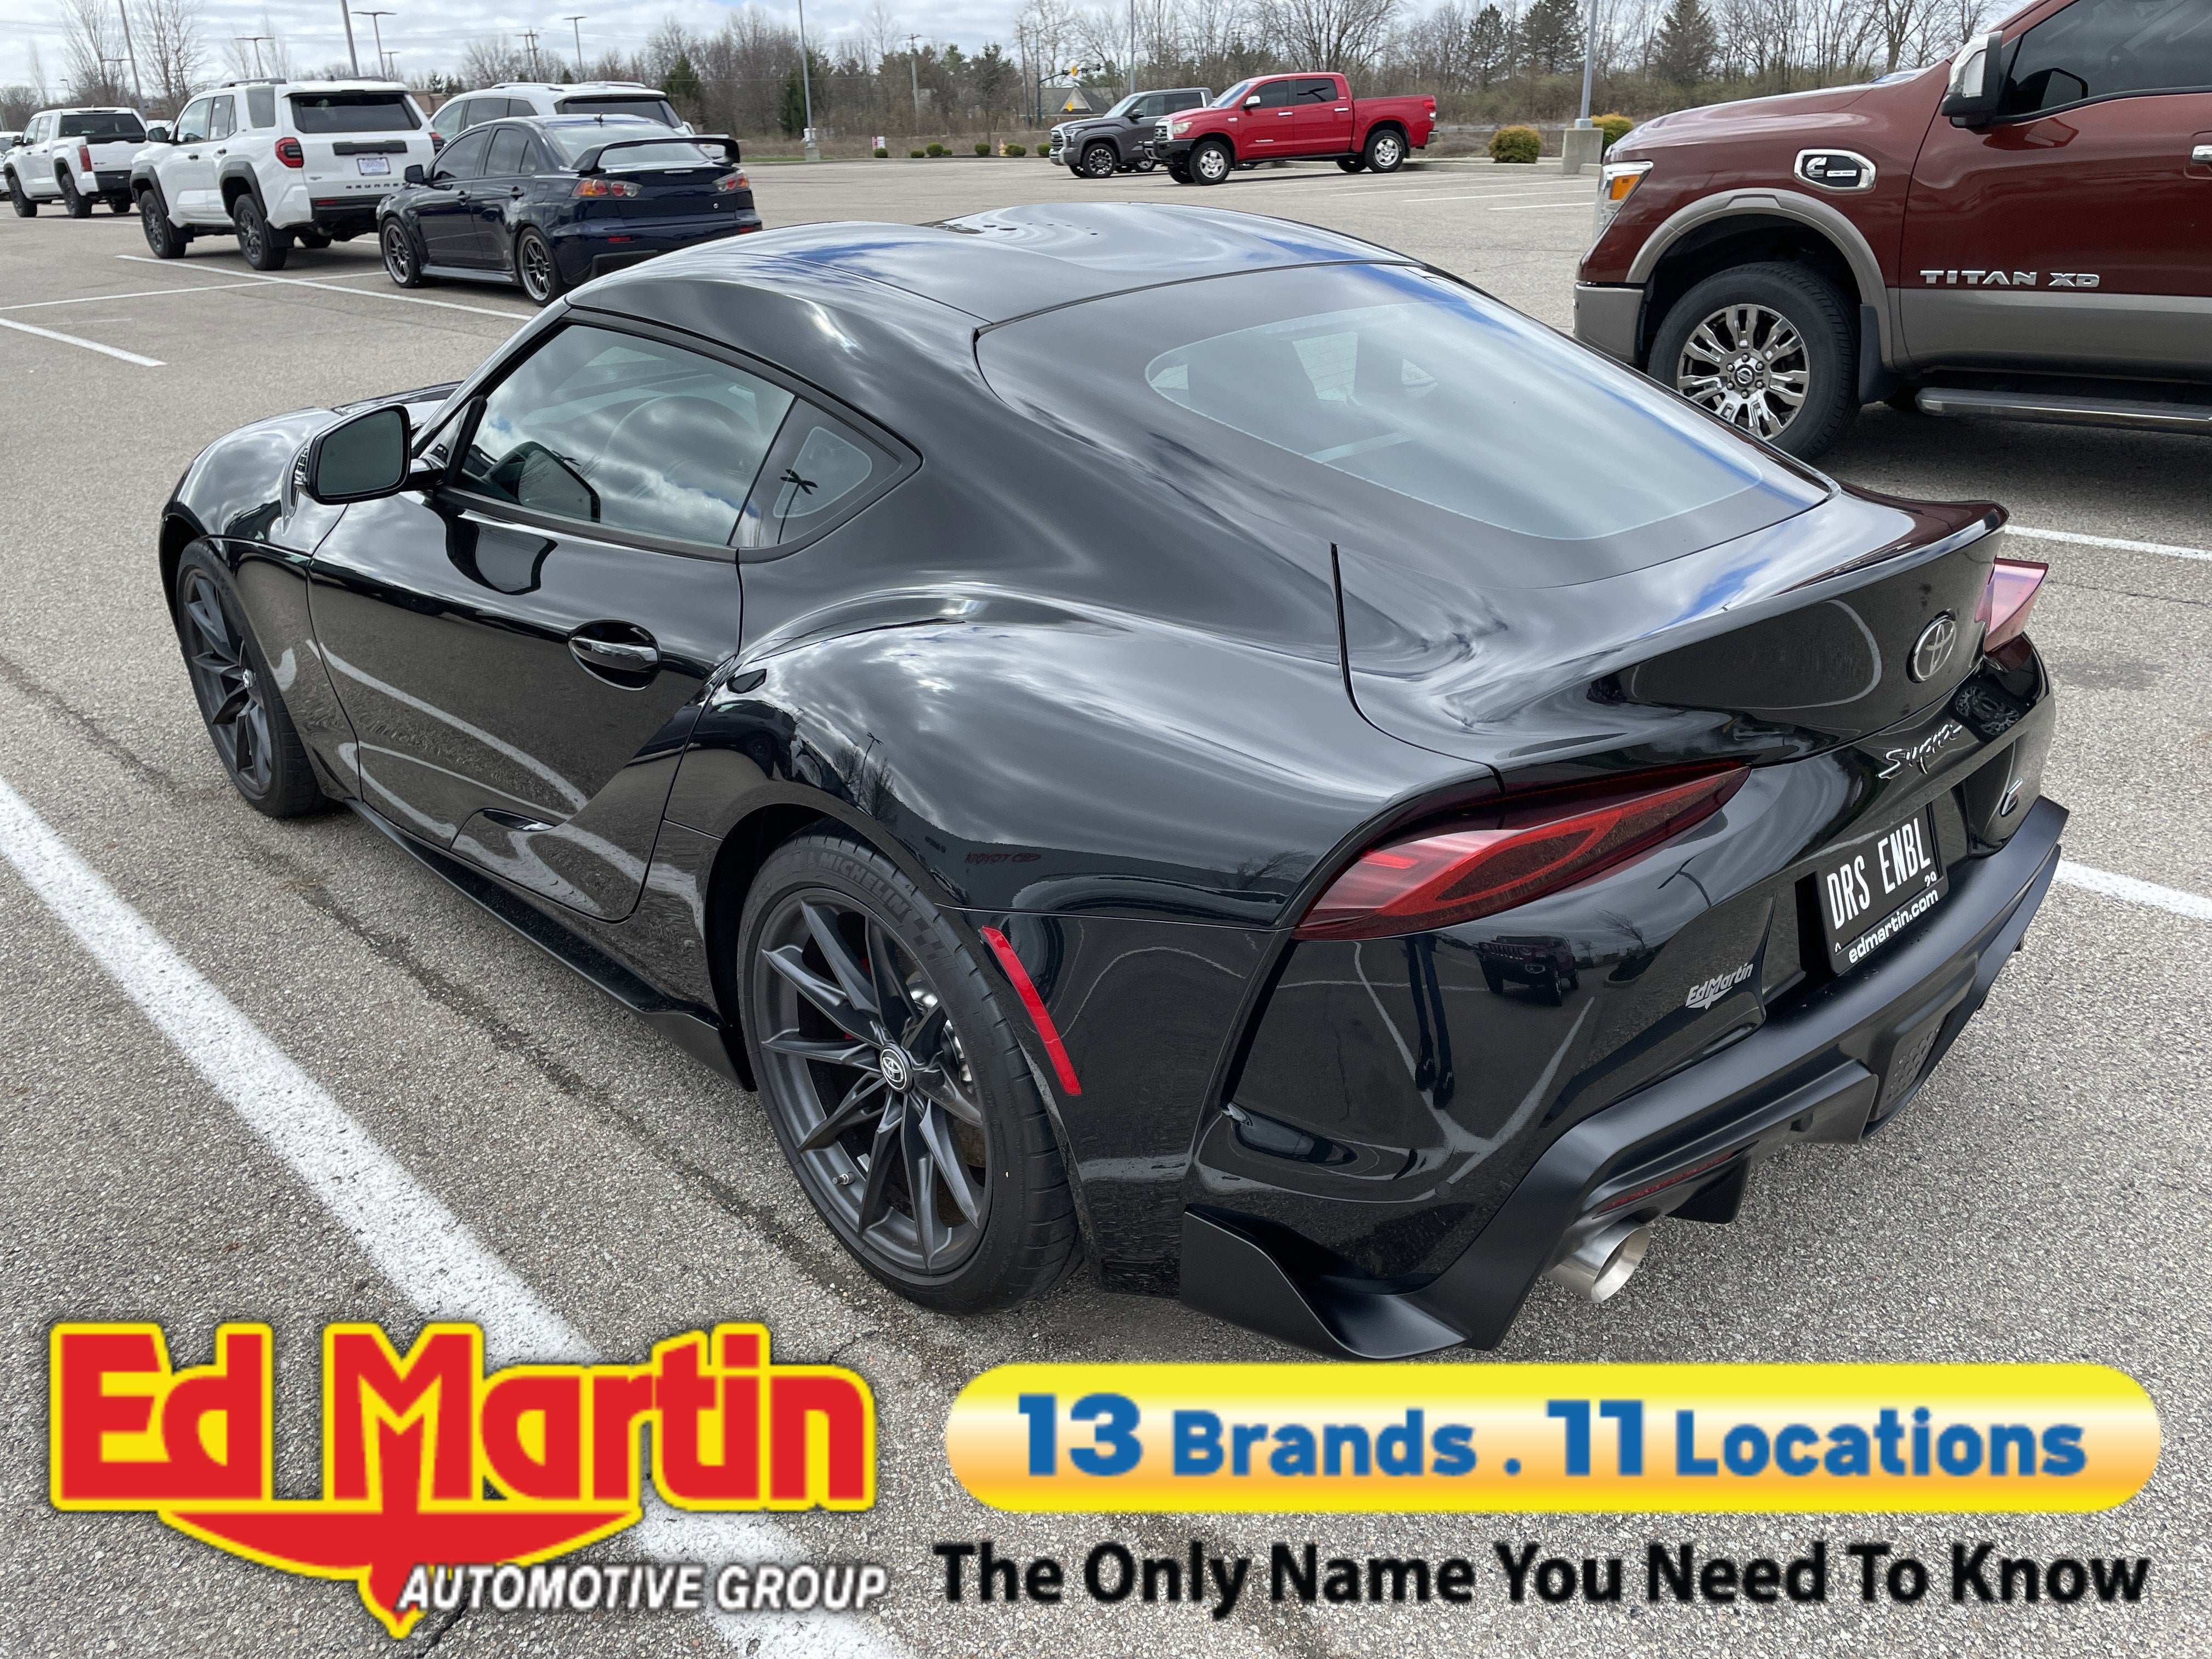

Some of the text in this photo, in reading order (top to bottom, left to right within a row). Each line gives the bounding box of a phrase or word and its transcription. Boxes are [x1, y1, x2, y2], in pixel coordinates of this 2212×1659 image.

[1920, 270, 2100, 288] TITAN XD
[1876, 724, 1962, 780] Supra
[819, 851, 912, 915] MICHELIN
[1826, 817, 1931, 930] DRS ENBL
[1848, 889, 1939, 964] edmartin.com
